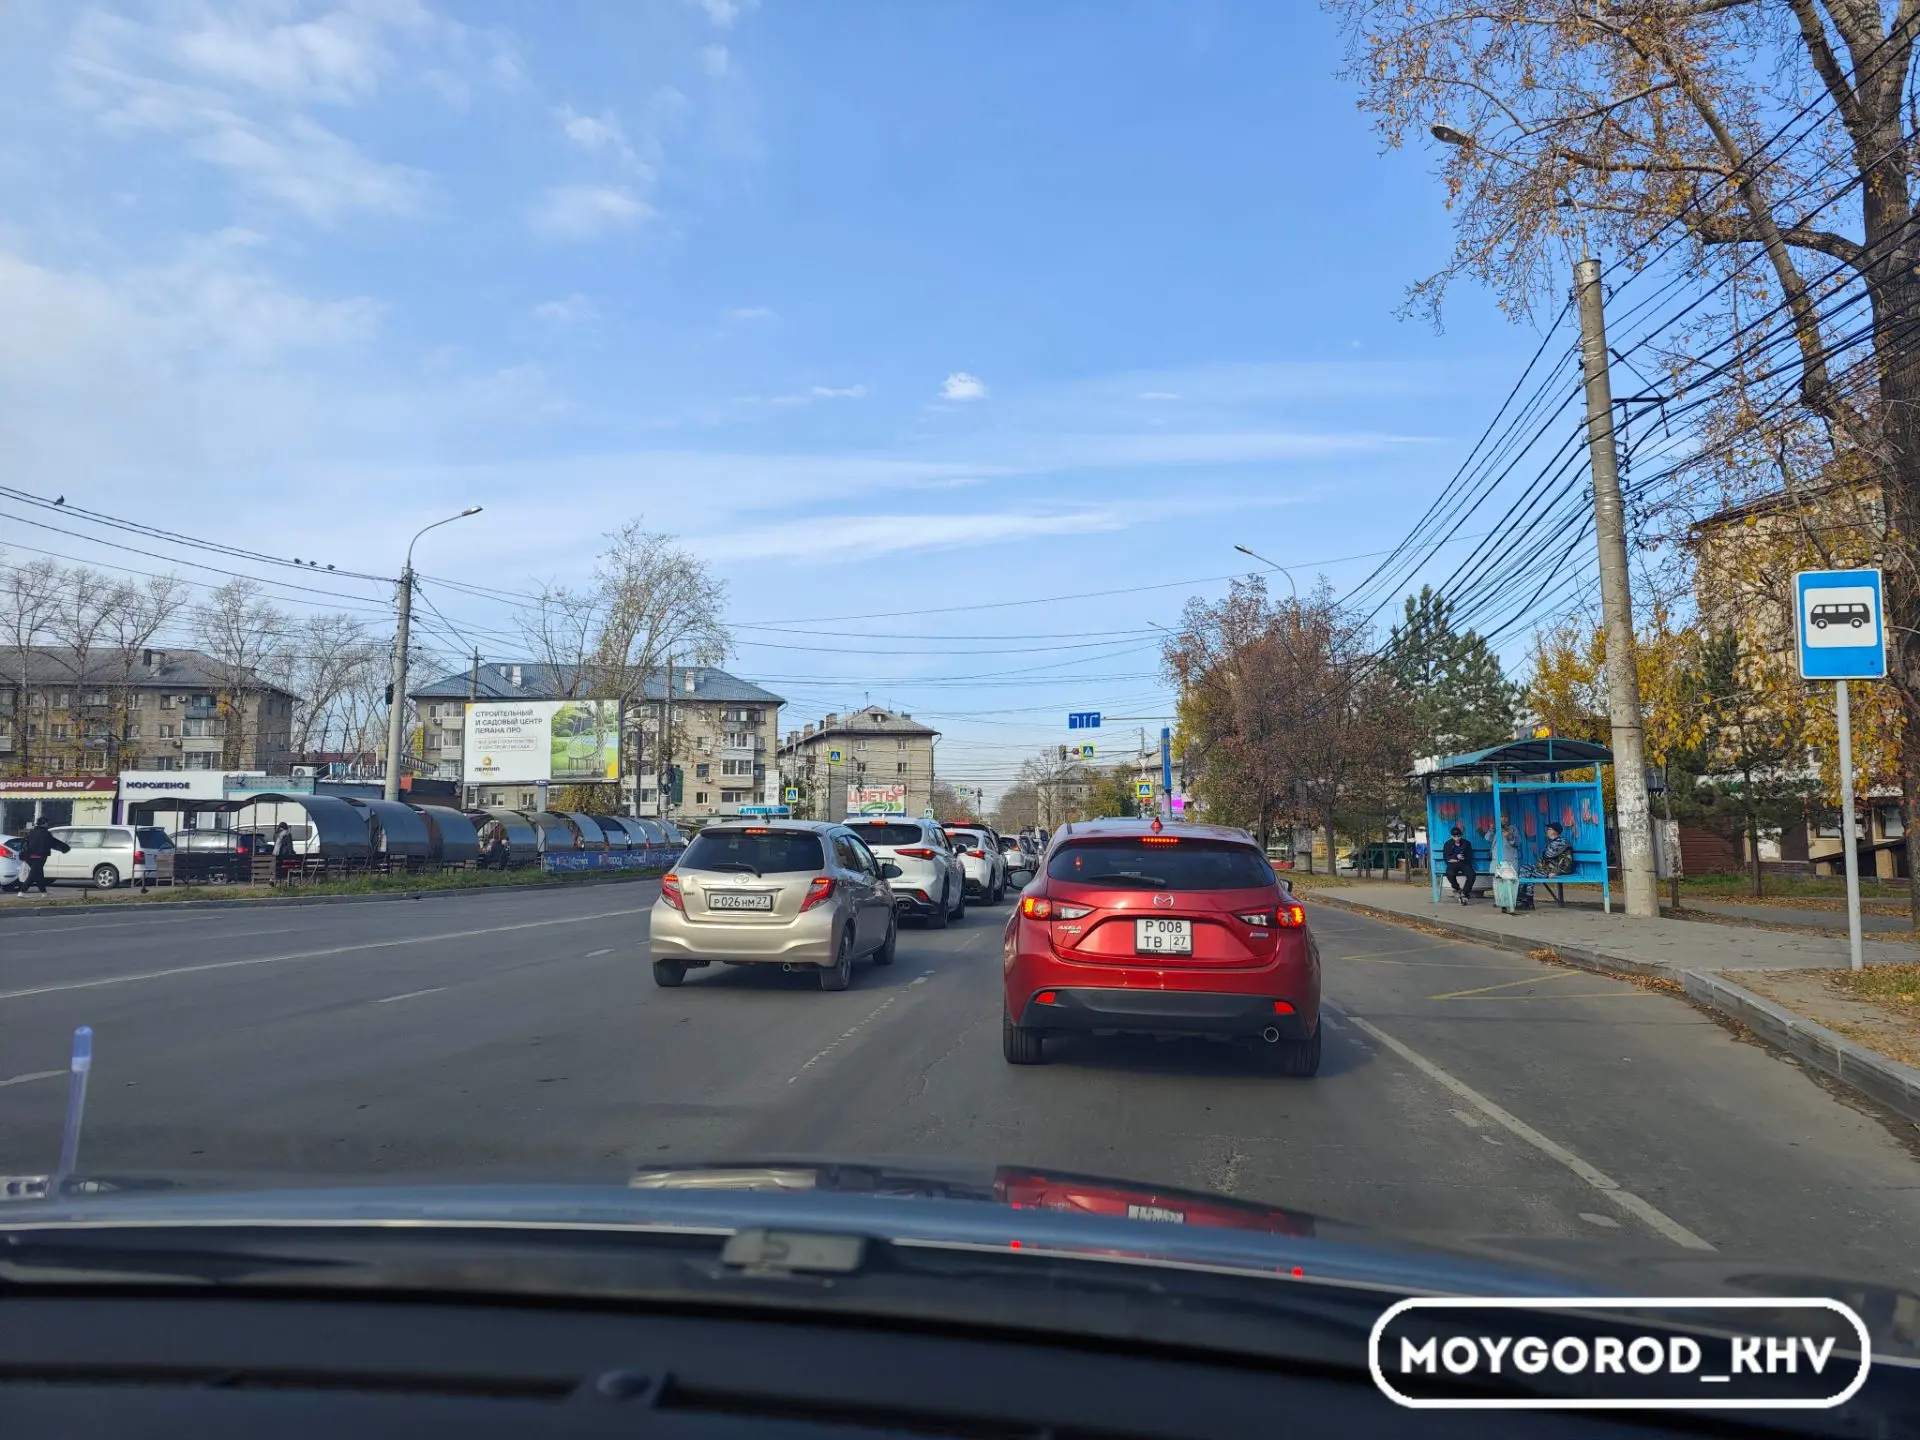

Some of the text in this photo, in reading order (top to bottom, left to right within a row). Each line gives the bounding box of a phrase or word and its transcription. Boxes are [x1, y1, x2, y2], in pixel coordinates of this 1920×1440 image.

[475, 709, 534, 717] СТРОИТЕЛЬНЫЙ
[46, 781, 54, 790] у
[55, 779, 84, 788] дома
[126, 781, 190, 790] МОРОЖЕНОЕ
[739, 807, 773, 815] АПТЕКА
[757, 897, 767, 905] 27
[1173, 936, 1187, 946] 27
